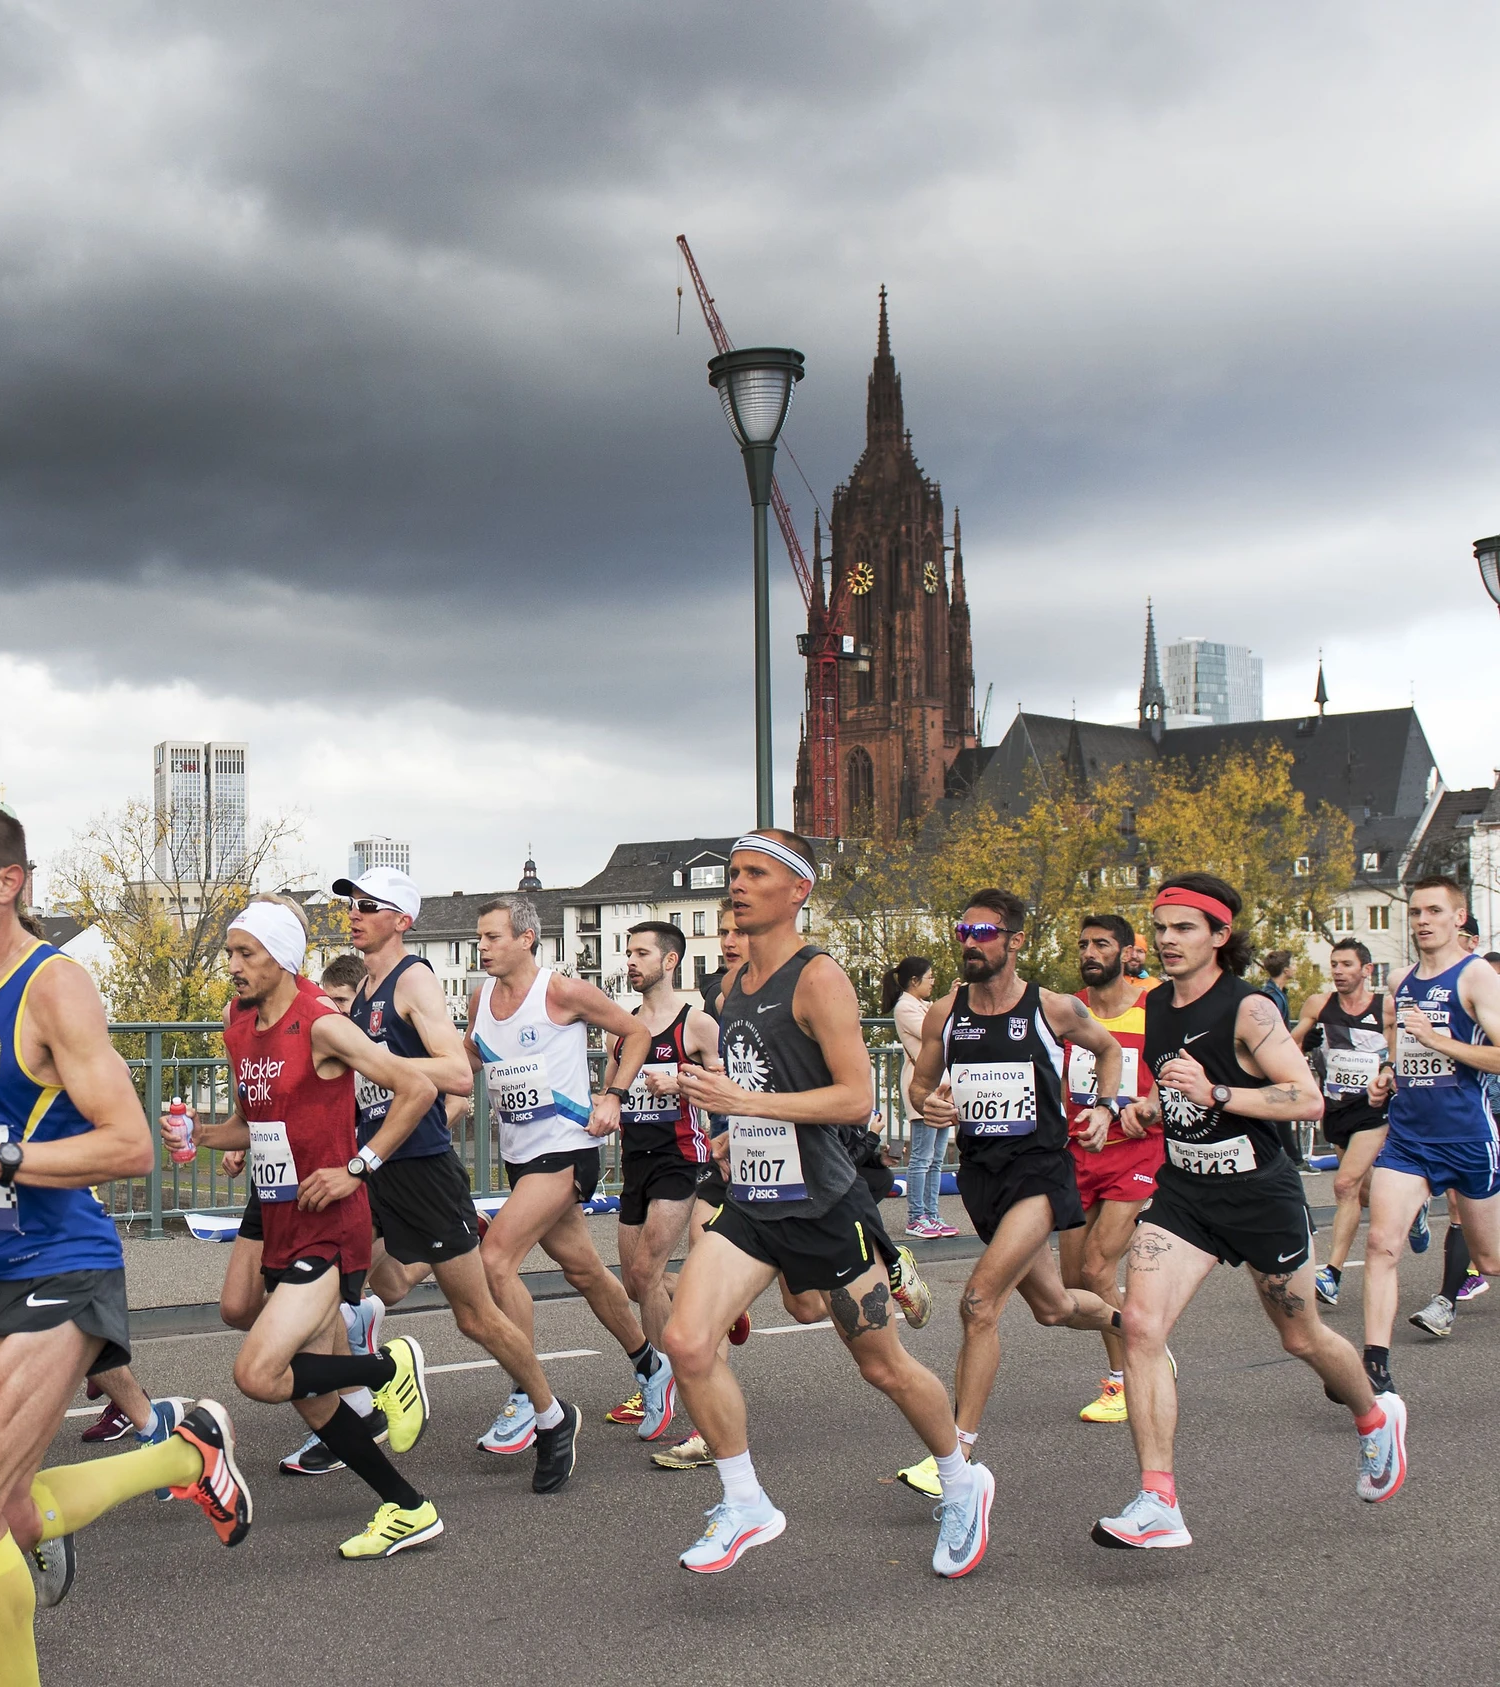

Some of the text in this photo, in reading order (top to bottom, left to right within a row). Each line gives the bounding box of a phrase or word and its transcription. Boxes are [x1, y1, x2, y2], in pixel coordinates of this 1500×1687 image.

[239, 1056, 285, 1081] Stickler
[496, 1063, 539, 1077] mainova
[1403, 1059, 1442, 1075] 8336
[970, 1070, 1025, 1081] mainova
[1335, 1072, 1369, 1086] 8852
[501, 1082, 526, 1092] Richard
[501, 1089, 539, 1111] 4893
[977, 1091, 1003, 1099] Darko
[628, 1094, 668, 1111] 9115
[962, 1099, 1024, 1120] 10611
[641, 1113, 660, 1121] asics
[740, 1125, 787, 1138] mainova
[984, 1124, 1009, 1134] asics
[746, 1148, 766, 1158] Peter
[1175, 1145, 1240, 1161] Martin Egebjerg
[740, 1159, 786, 1182] 6107
[755, 1188, 779, 1199] asics
